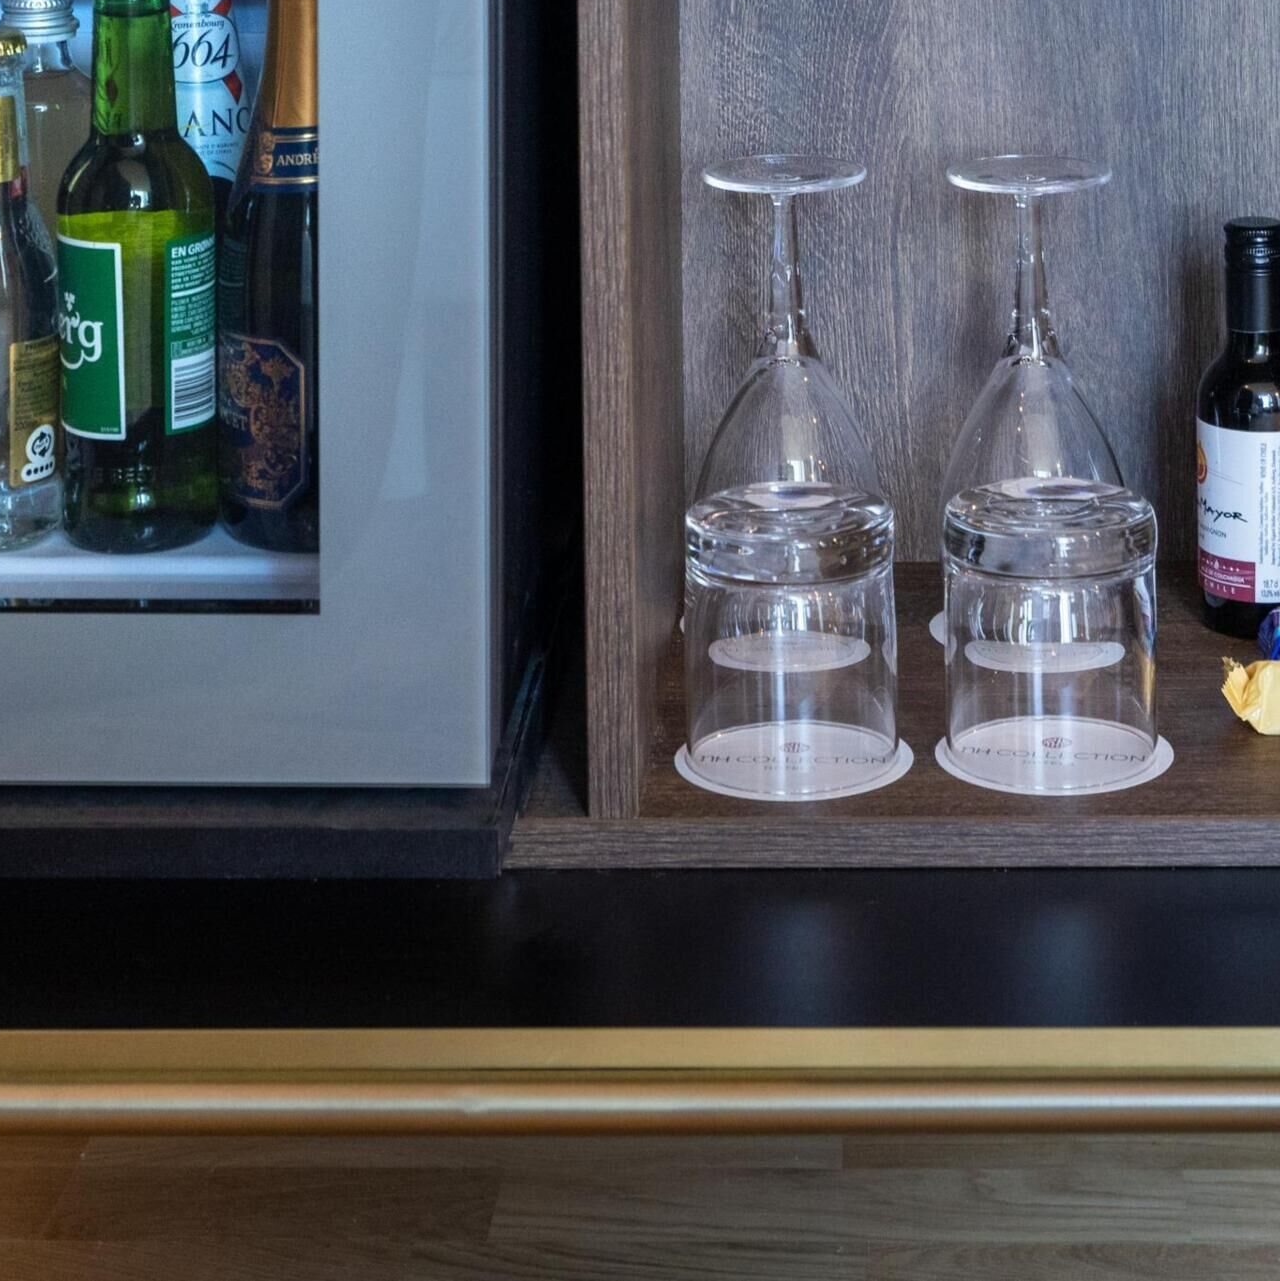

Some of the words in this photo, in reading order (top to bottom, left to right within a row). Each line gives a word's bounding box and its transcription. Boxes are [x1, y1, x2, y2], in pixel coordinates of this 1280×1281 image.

[172, 29, 233, 69] 664
[171, 246, 187, 259] EN
[1204, 579, 1237, 596] CHILE
